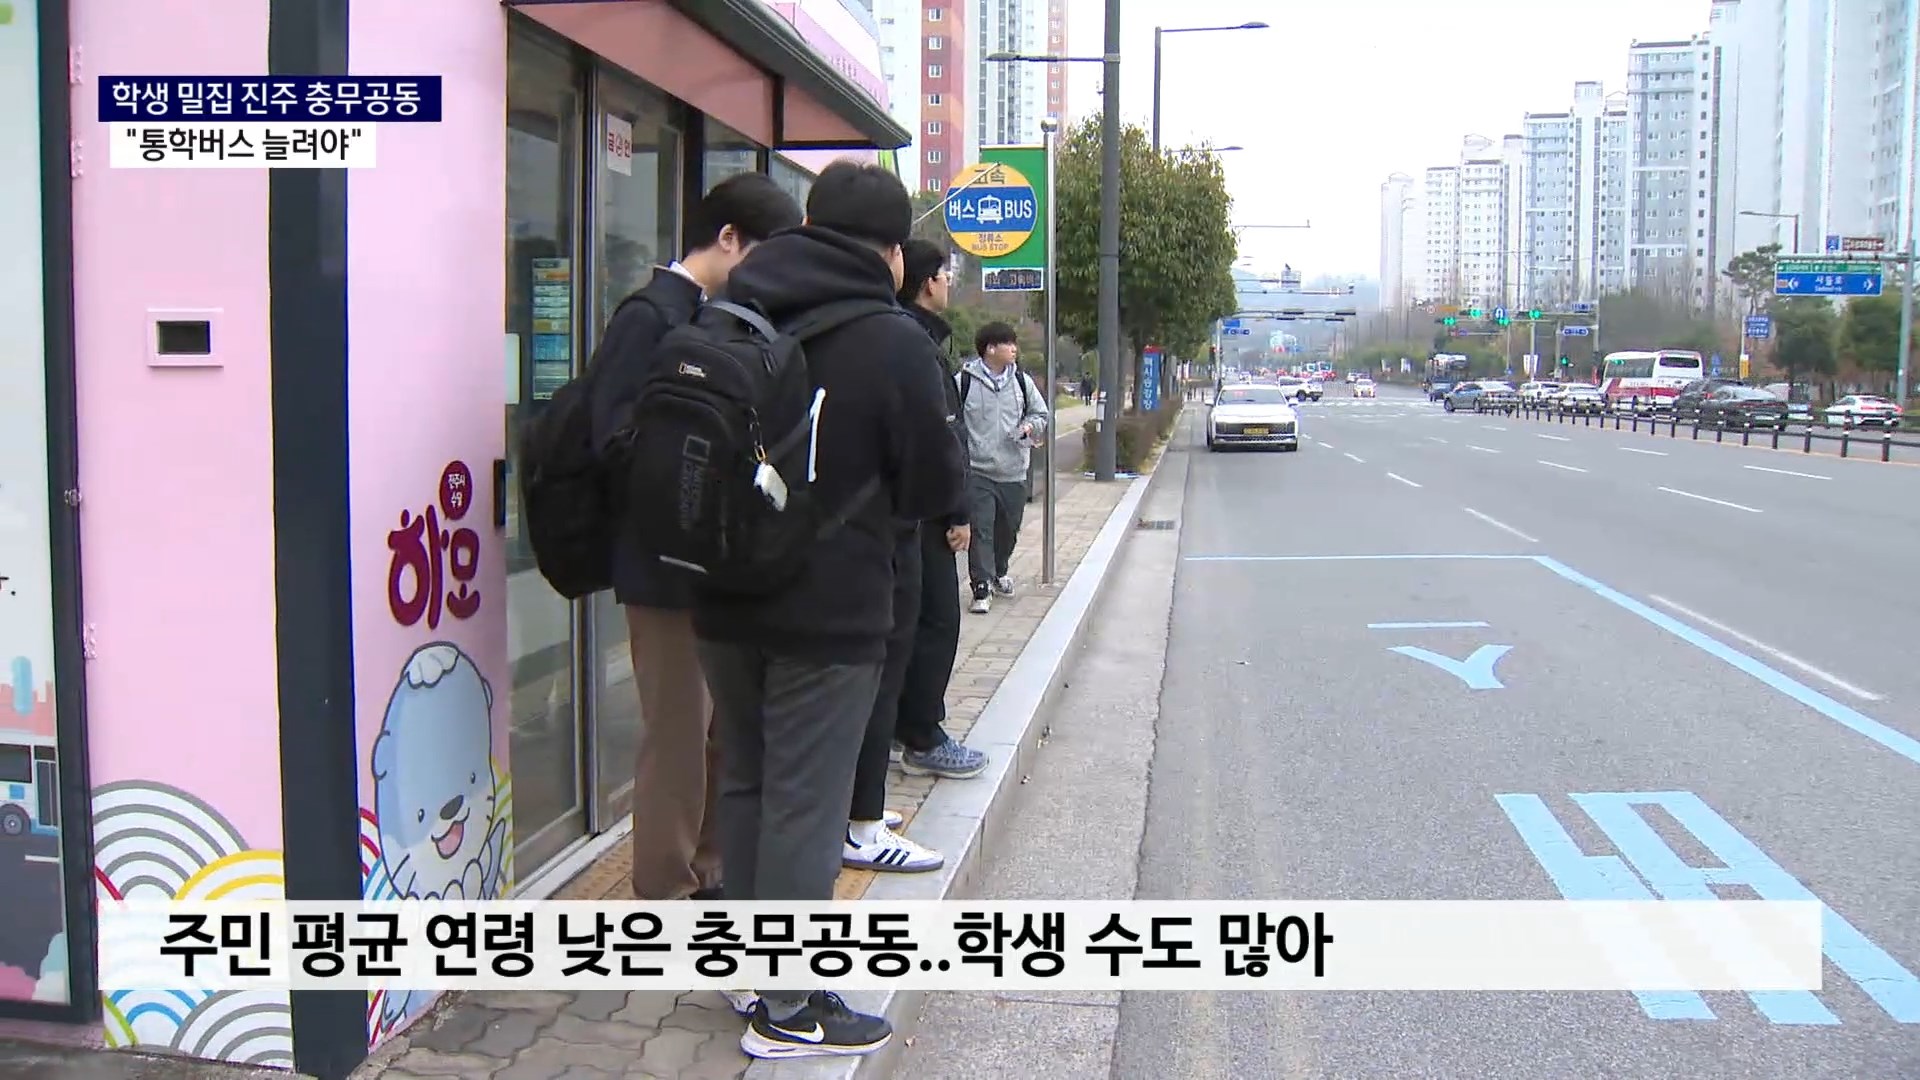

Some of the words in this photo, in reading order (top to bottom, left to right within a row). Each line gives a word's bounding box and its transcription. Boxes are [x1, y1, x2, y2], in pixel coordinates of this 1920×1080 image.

[973, 168, 1006, 185] 고속
[949, 199, 976, 221] 버스
[1004, 198, 1033, 219] BUS
[977, 232, 1004, 243] 정류소
[971, 243, 989, 253] BUS
[989, 243, 1010, 252] STOP
